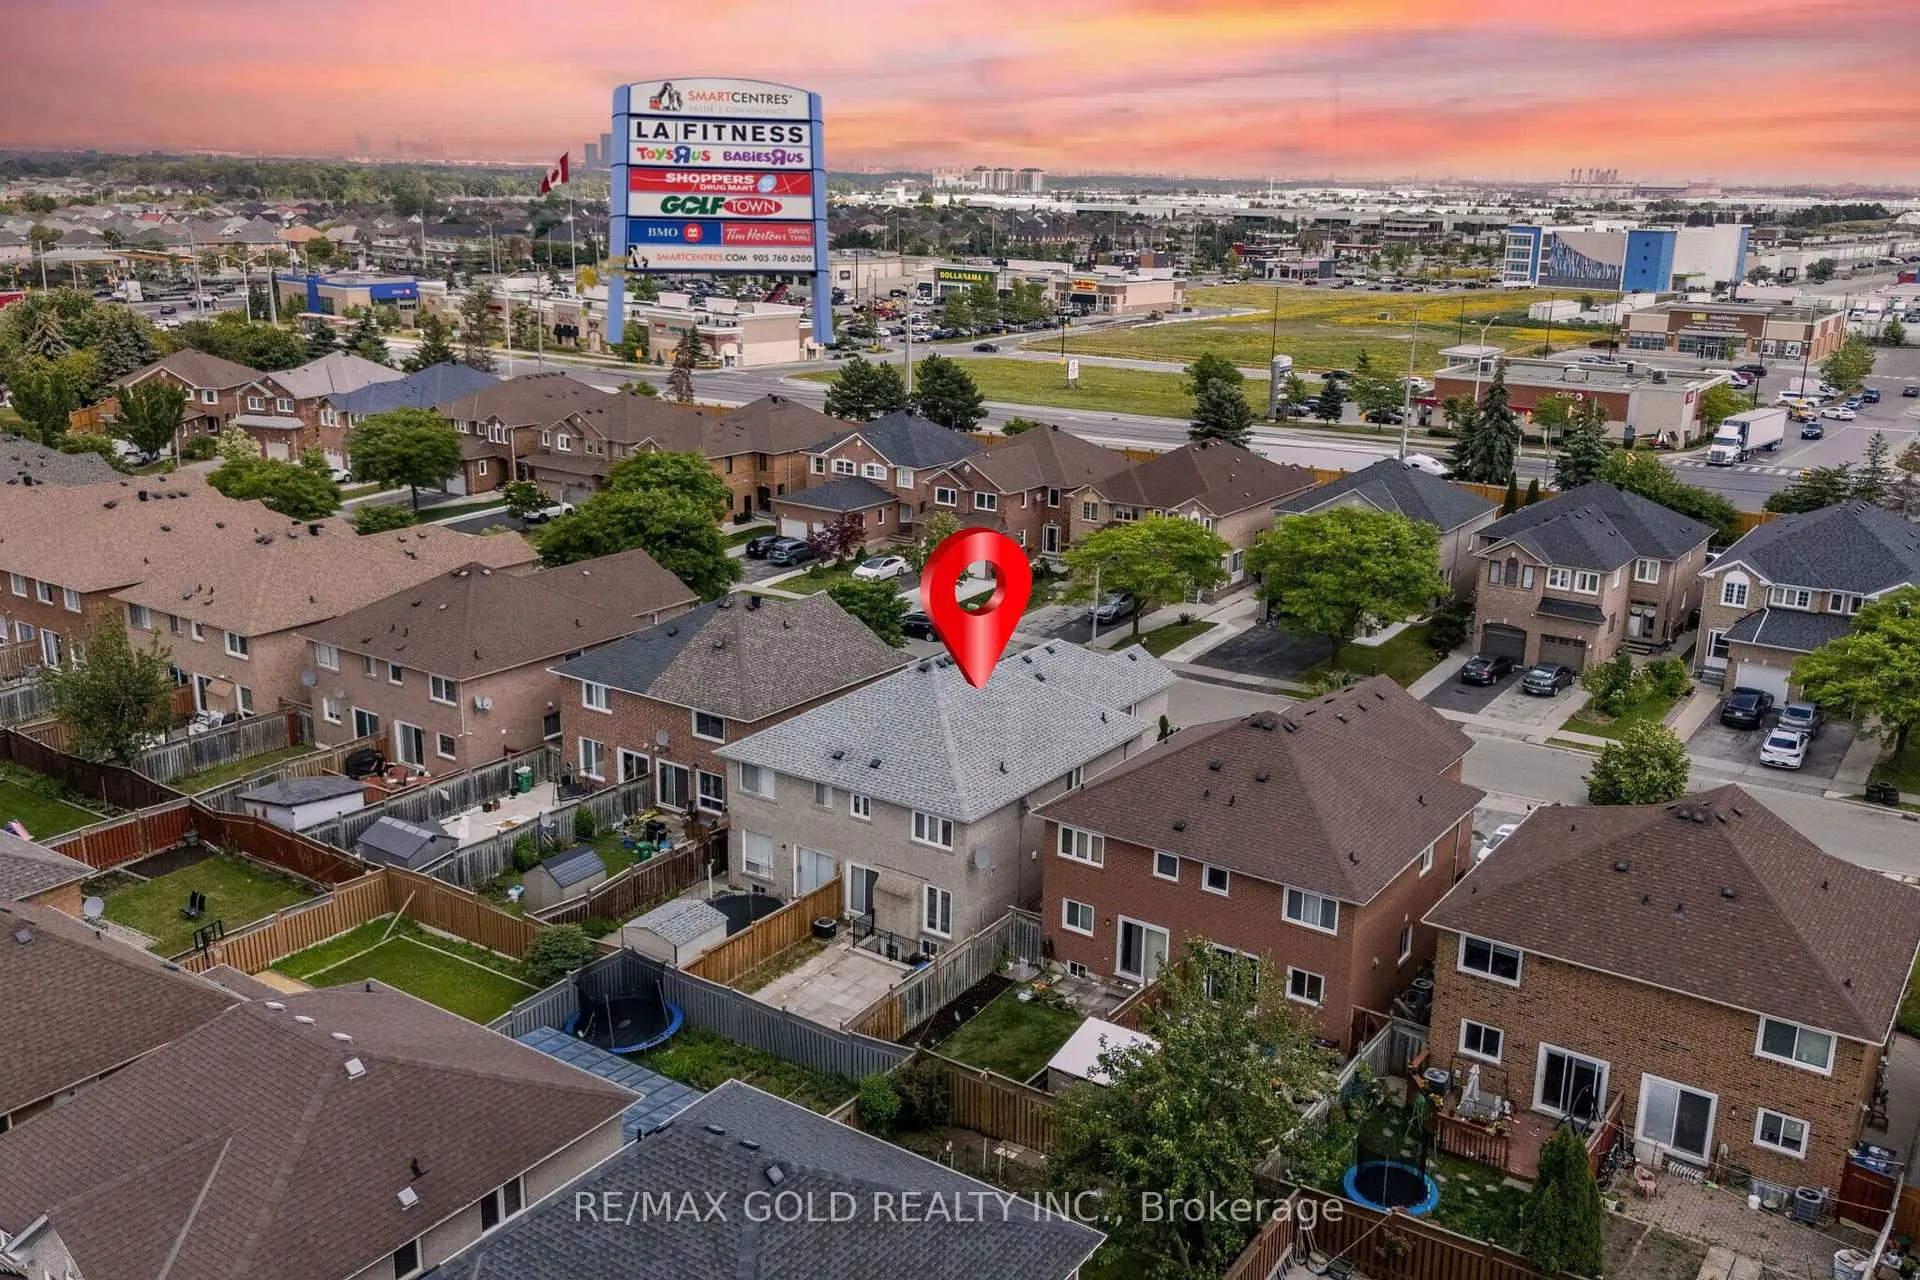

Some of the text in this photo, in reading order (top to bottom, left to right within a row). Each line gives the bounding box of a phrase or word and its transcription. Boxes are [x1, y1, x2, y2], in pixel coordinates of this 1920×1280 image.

[665, 173, 755, 185] SHOPPERS
[699, 183, 754, 192] DRUG MART
[660, 195, 776, 215] GOLF TOWN
[648, 227, 678, 237] BMO
[726, 227, 786, 241] Tim Hortons
[752, 254, 769, 262] 905
[773, 254, 788, 262] 760
[791, 254, 813, 263] 6200
[940, 271, 982, 281] DOLLARAMA
[1709, 314, 1740, 322] Healthcare
